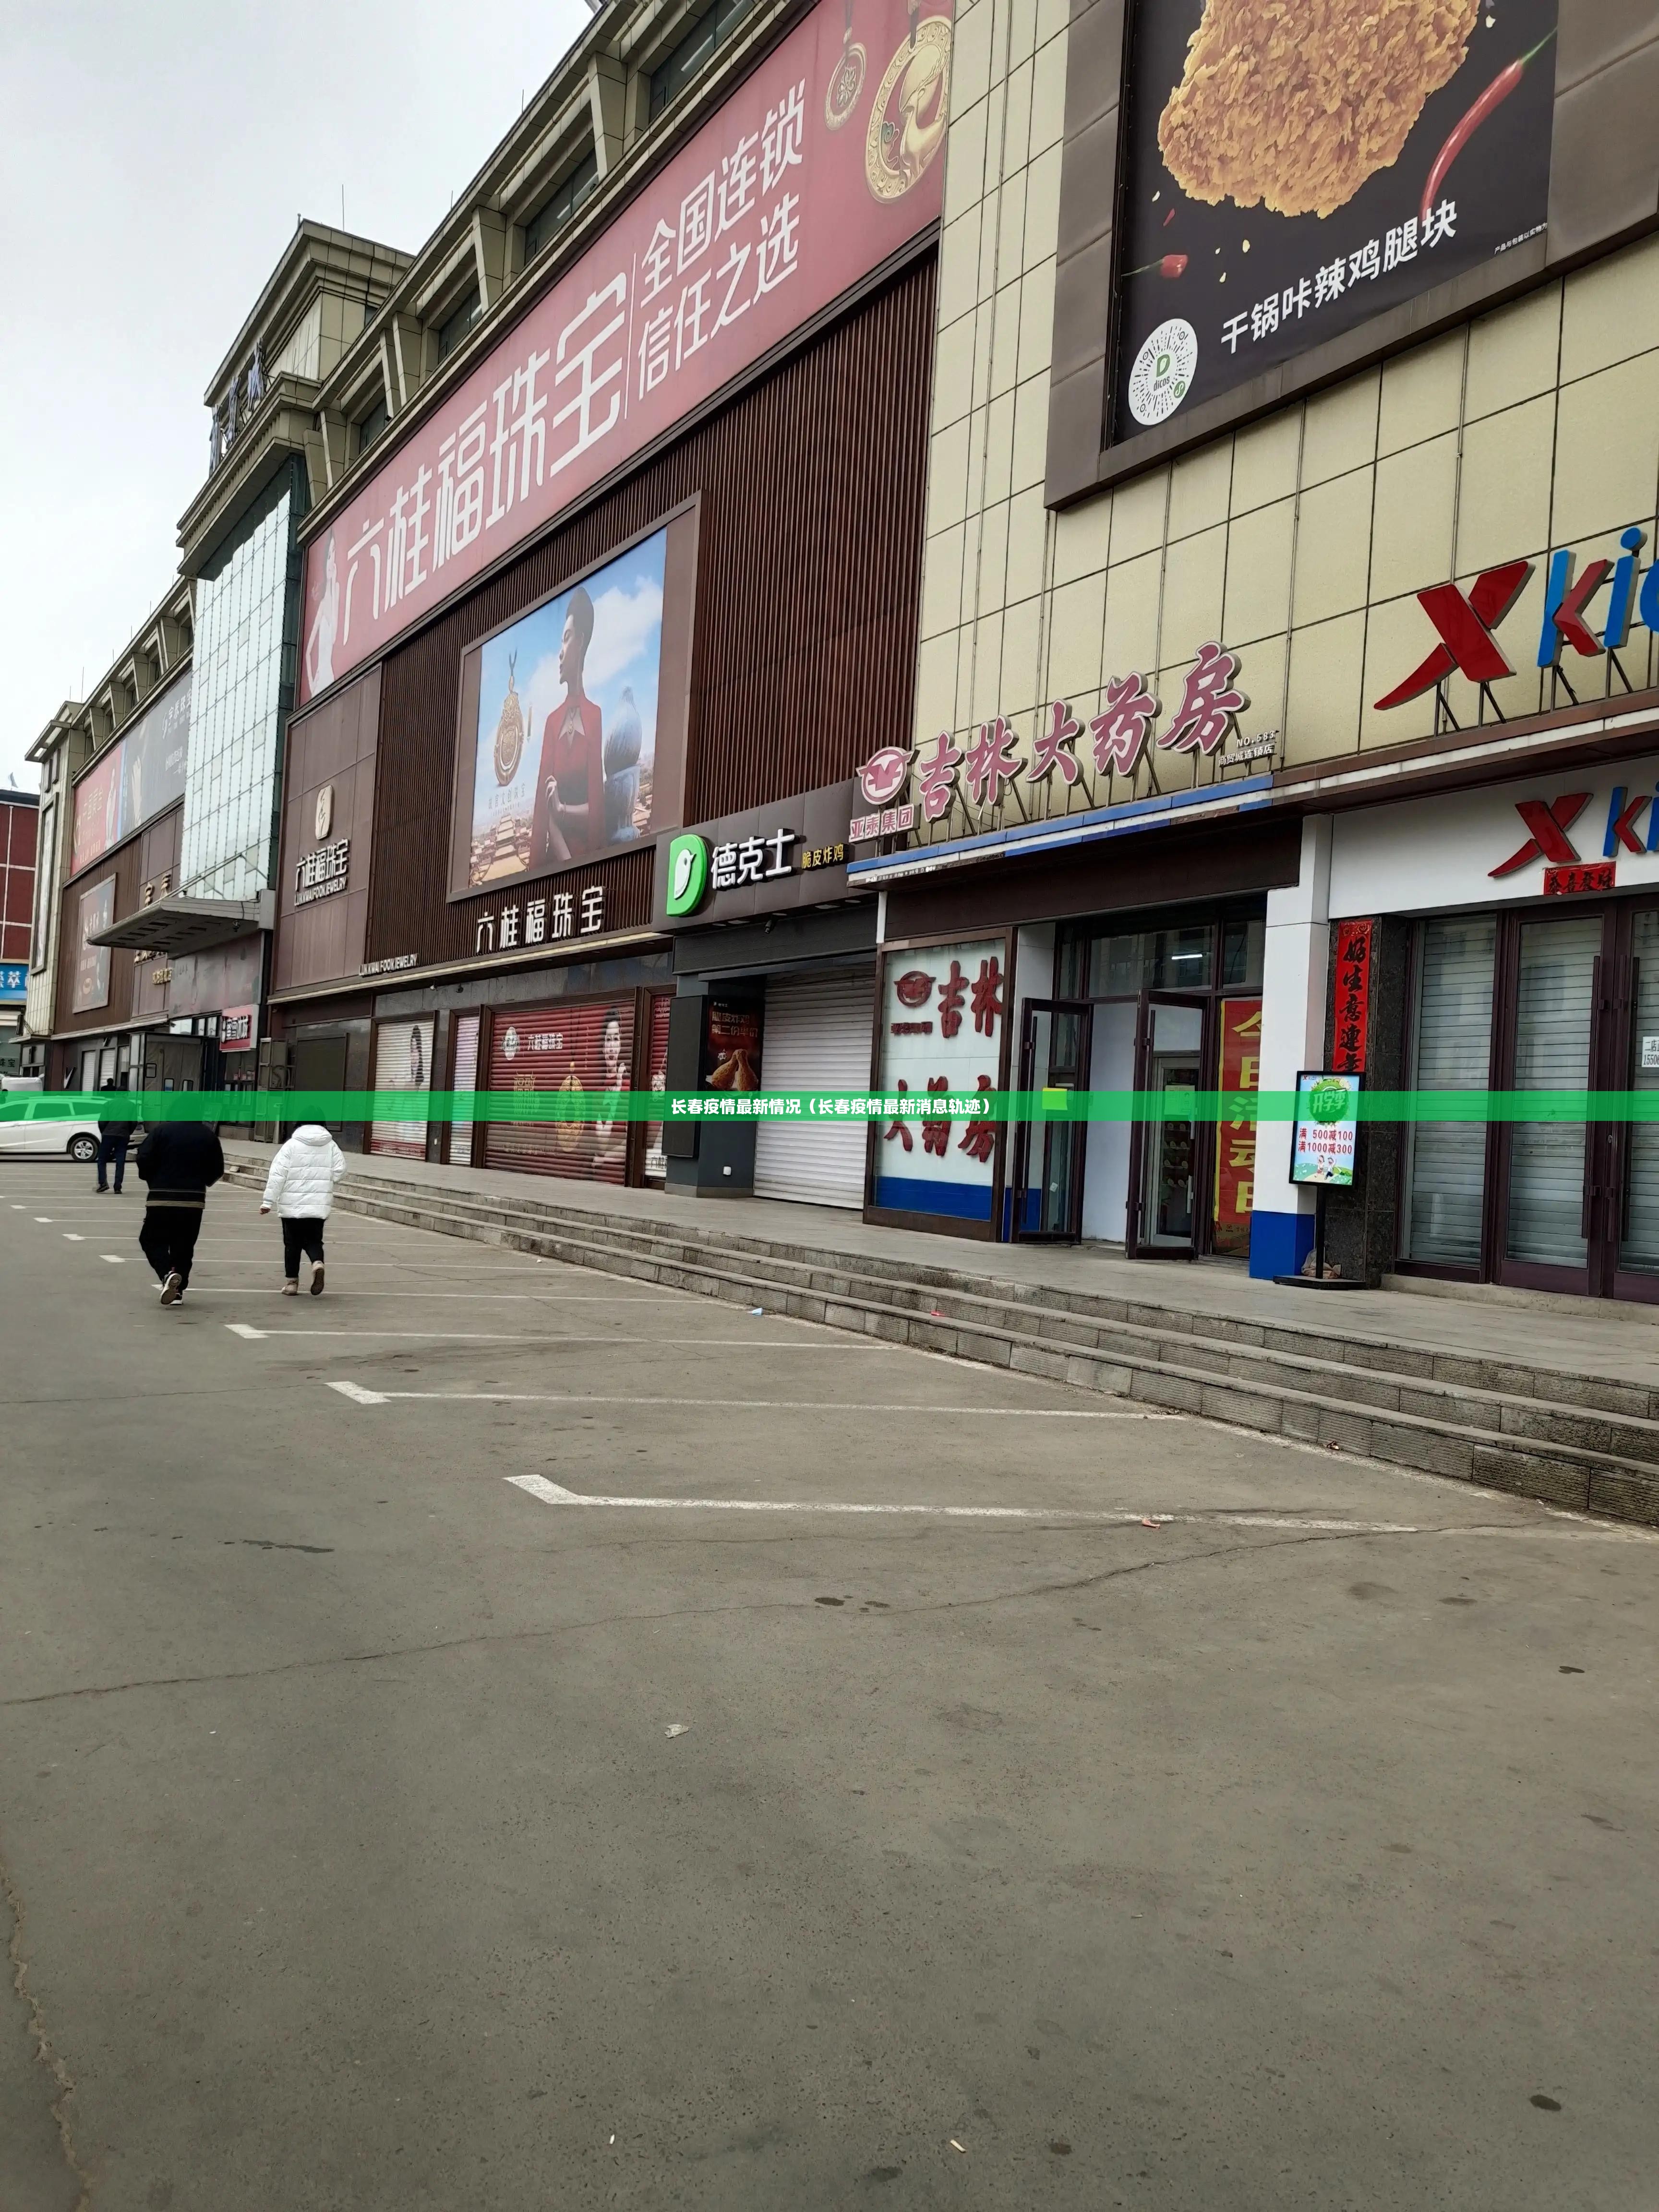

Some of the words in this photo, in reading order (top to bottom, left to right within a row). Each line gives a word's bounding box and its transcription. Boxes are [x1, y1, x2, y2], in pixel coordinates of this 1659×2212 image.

[641, 78, 805, 308] 全国连锁
[638, 193, 800, 401] 信任之选
[1221, 198, 1457, 354] 干锅咔辣鸡腿块
[1154, 376, 1170, 391] dicos
[343, 272, 627, 646] 六桂福珠宝
[919, 641, 1250, 824] 吉林大药房
[1218, 744, 1274, 767] 商贸城连锁店
[1237, 730, 1276, 748] NO.583
[850, 806, 913, 841] 亚泰集团
[296, 839, 349, 891] 六桂福珠宝
[711, 828, 796, 889] 德克士
[802, 843, 845, 869] 脆皮炸鸡
[476, 886, 603, 953] 六桂福珠宝
[938, 956, 1004, 1038] 吉林
[1313, 1089, 1346, 1113] 开学季
[1298, 1141, 1353, 1154] 满1000减300
